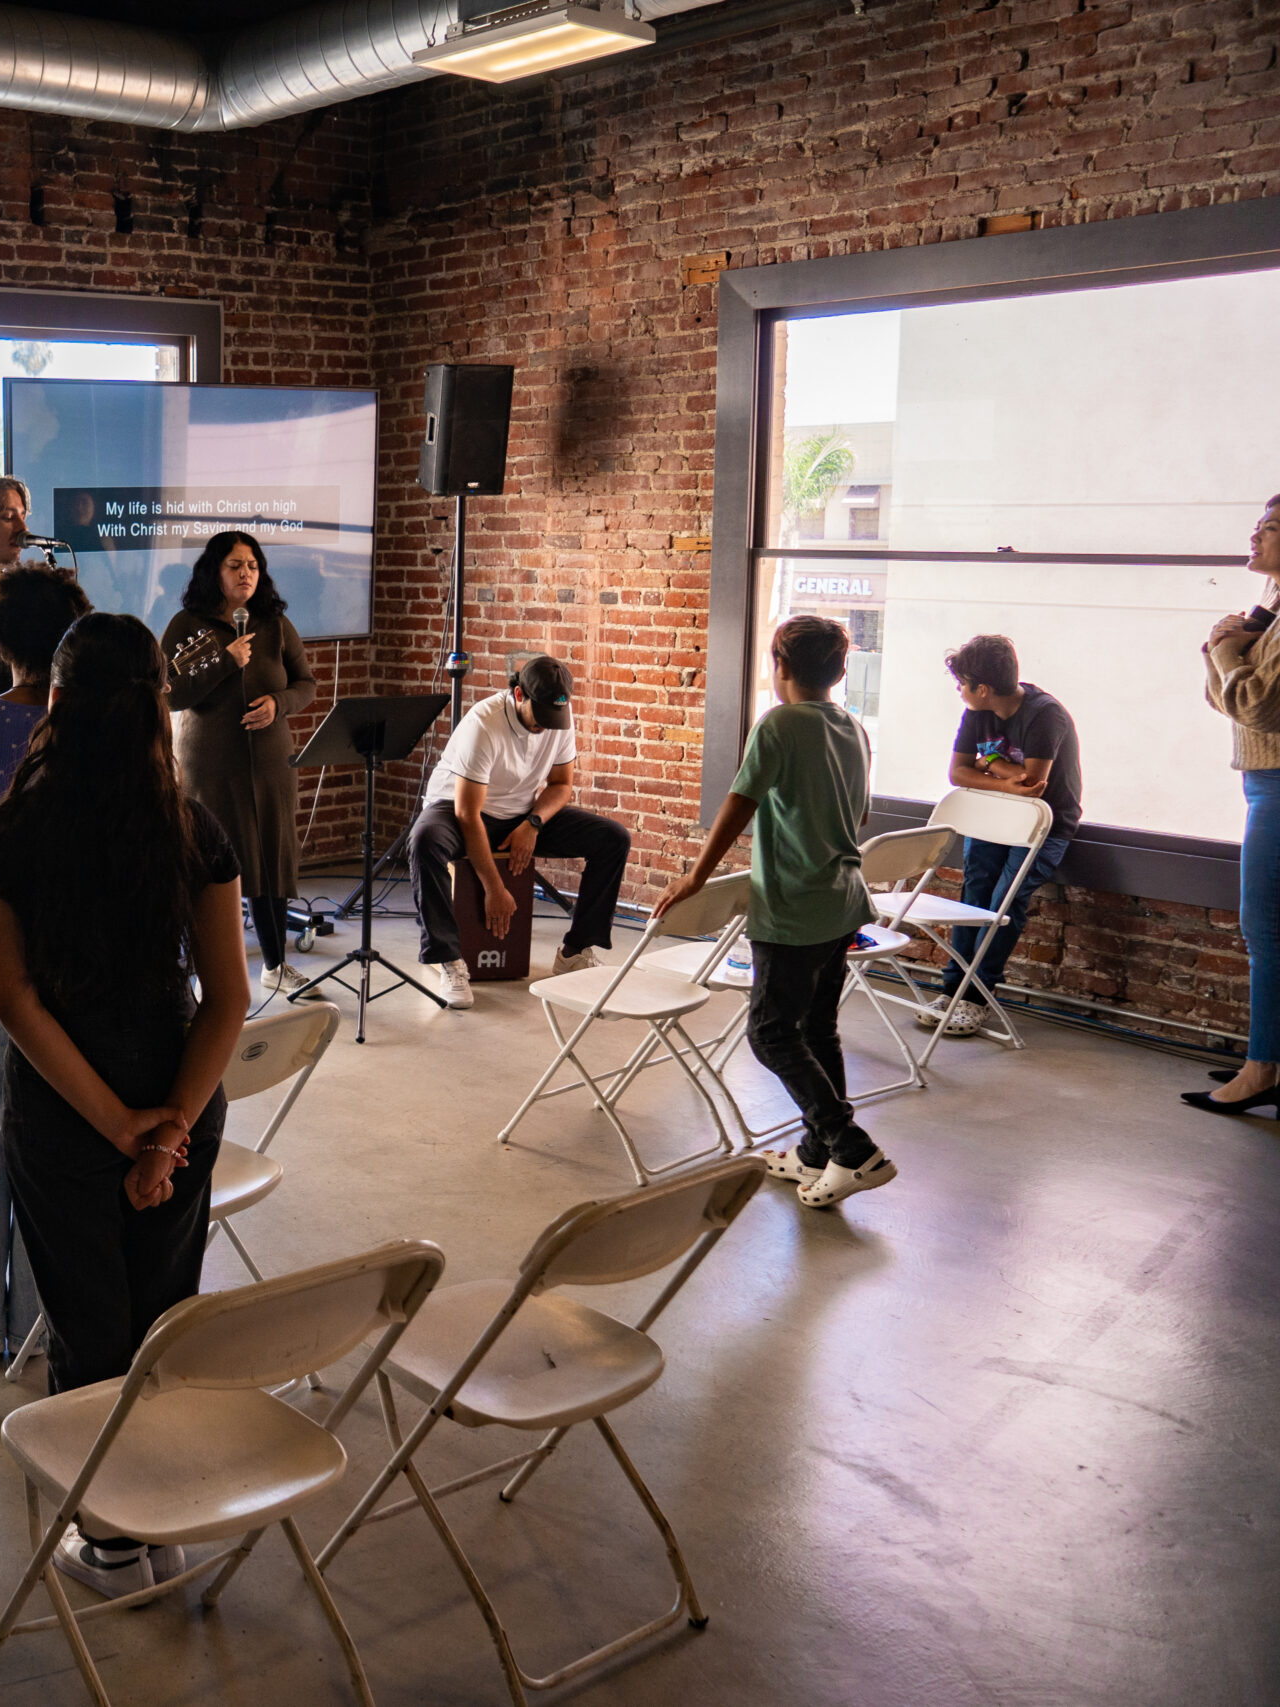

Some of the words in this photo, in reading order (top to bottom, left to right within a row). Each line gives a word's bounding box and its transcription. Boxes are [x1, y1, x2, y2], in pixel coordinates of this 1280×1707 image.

[106, 501, 124, 518] My
[129, 501, 148, 515] life
[151, 501, 162, 514] is
[166, 501, 185, 514] hid
[189, 500, 213, 514] with
[216, 499, 251, 513] Christ
[255, 502, 269, 512] on
[273, 499, 297, 514] high
[97, 523, 126, 537] With
[130, 522, 168, 536] Christ
[171, 524, 189, 538] my
[193, 521, 232, 535] Savior
[235, 520, 256, 533] and
[260, 523, 277, 535] my
[280, 519, 303, 532] God
[795, 576, 873, 596] GENERAL
